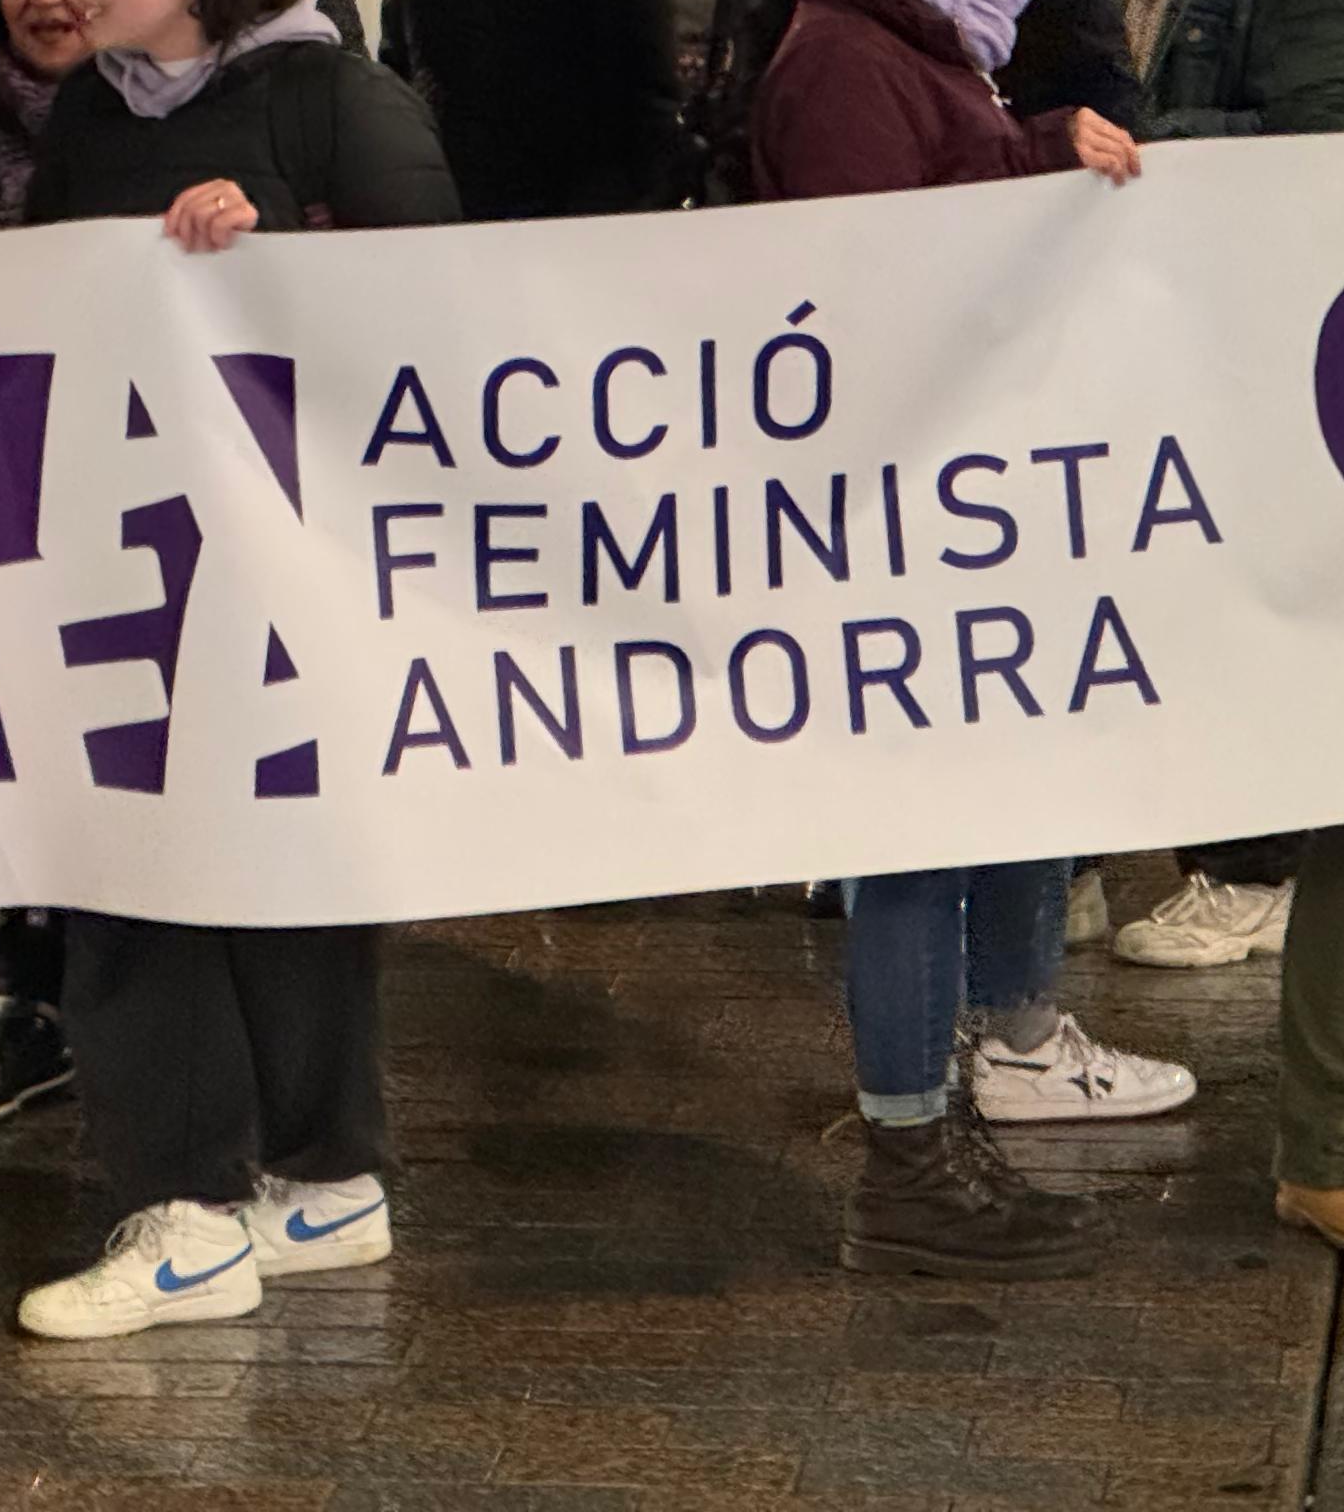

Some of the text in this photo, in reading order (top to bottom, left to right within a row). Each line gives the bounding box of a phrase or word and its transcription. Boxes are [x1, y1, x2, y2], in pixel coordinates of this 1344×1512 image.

[361, 300, 833, 470] ACCIÓ
[371, 434, 1225, 622] FEMINISTA
[380, 594, 1162, 778] ANDORRA
